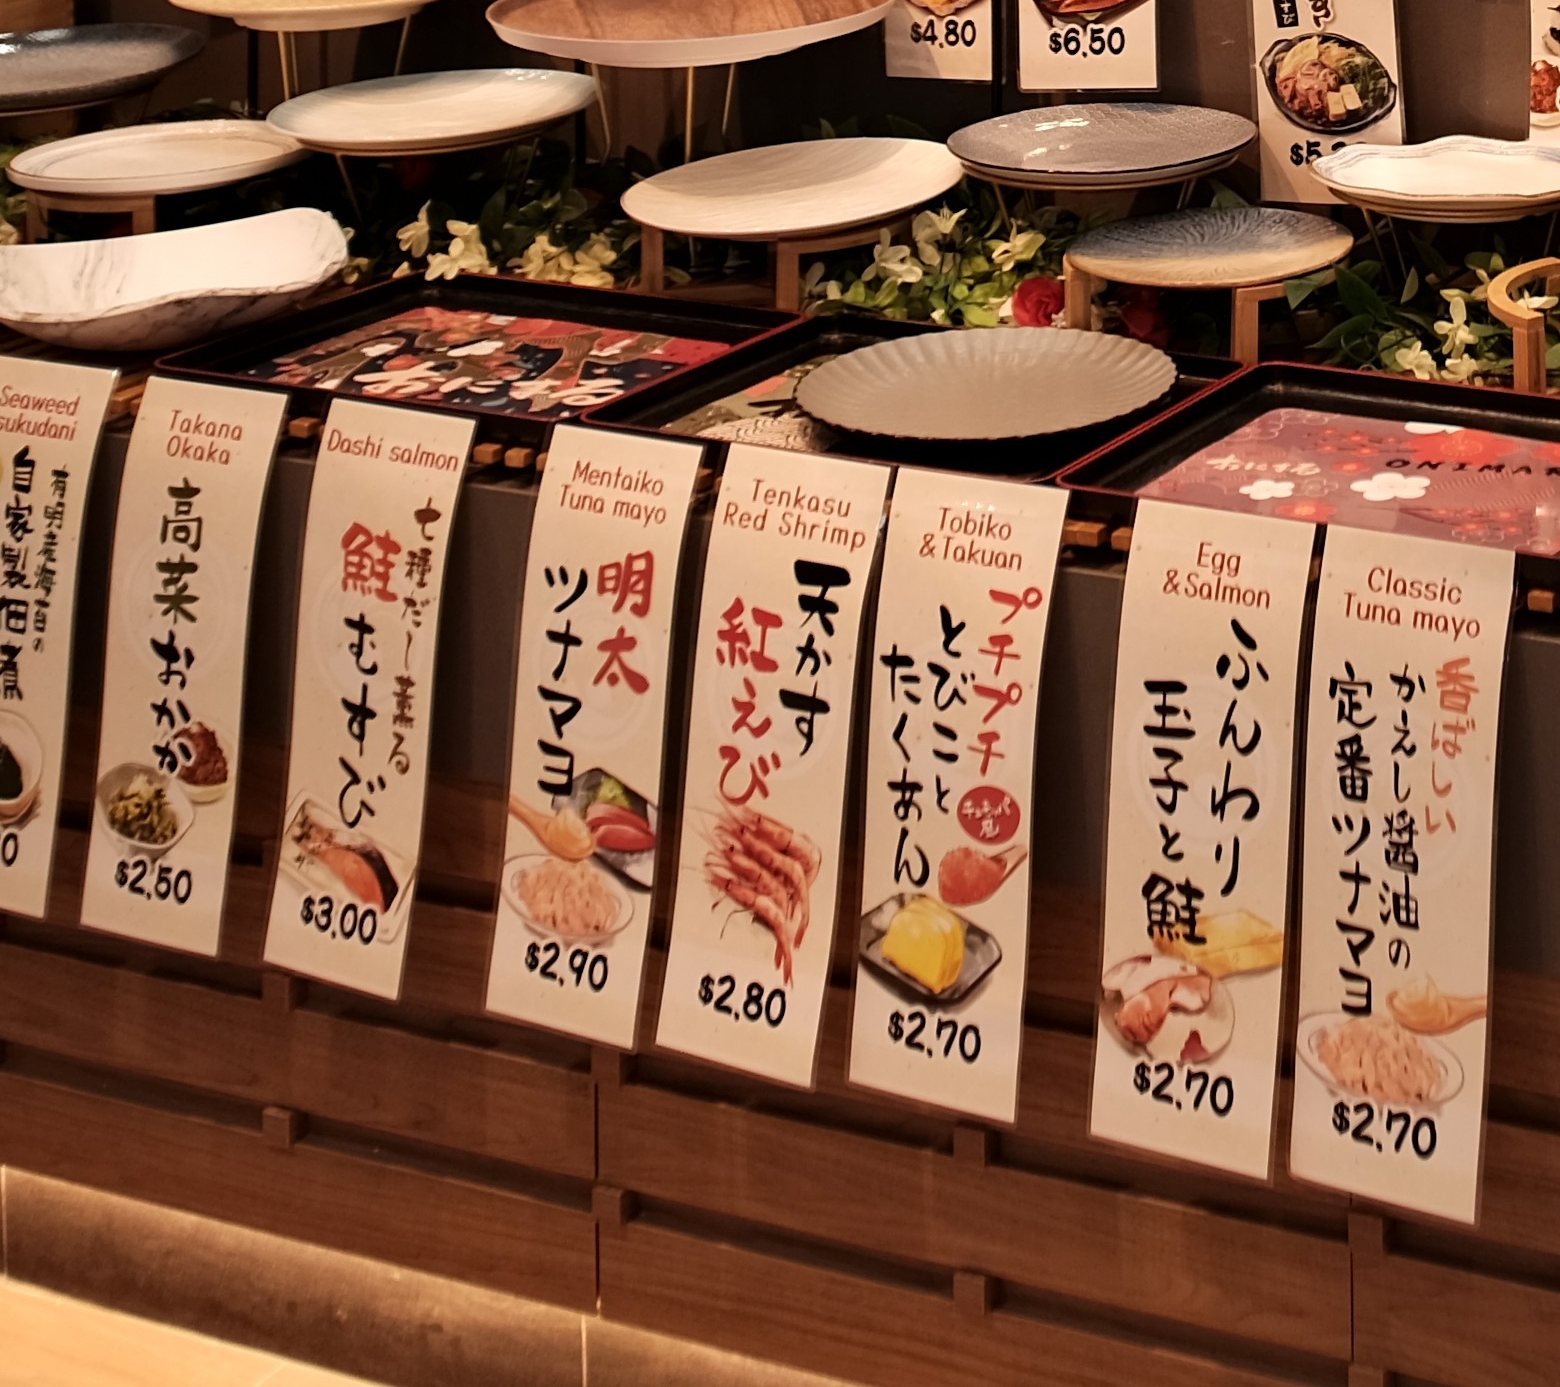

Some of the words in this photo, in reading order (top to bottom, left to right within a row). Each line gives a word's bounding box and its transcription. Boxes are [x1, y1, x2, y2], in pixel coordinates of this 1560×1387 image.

[911, 19, 976, 47] $4.80
[1049, 27, 1125, 57] $6.50
[166, 435, 231, 465] Okaka
[169, 410, 243, 442] Takana
[327, 429, 383, 460] Dashi
[388, 442, 459, 473] salmon
[558, 484, 606, 515] Tuna
[612, 500, 667, 526] mayo
[572, 461, 664, 496] Mentaiko
[751, 478, 851, 519] Tenkasu
[724, 502, 769, 530] Red
[777, 509, 866, 552] Shrimp
[938, 507, 1012, 541] Tobiko
[1197, 541, 1242, 577] Egg
[1367, 566, 1463, 606] Classic
[149, 477, 203, 774] 高菜おかか
[592, 550, 655, 694] 明太
[1343, 591, 1401, 625] Tuna
[1412, 608, 1482, 640] mayo
[338, 522, 402, 828] 鮭むすび
[537, 566, 588, 796] ツナマヨ
[779, 560, 851, 757] 天かす
[967, 586, 1042, 776] プチプチ
[716, 596, 784, 806] 紅えび
[927, 605, 976, 814] とびこと
[880, 645, 930, 890] たくあん
[1211, 618, 1269, 897] ふんわり
[1424, 658, 1480, 836] 香ばしい
[1142, 679, 1207, 945] 玉子と鮭
[1328, 661, 1377, 1017] 定番ツナマヨ
[1379, 663, 1426, 972] かえし醤油の
[115, 858, 192, 905] $2.50
[300, 897, 378, 945] $3.00
[525, 942, 609, 992] $2.90
[699, 974, 787, 1028] $2.80
[889, 1009, 981, 1063] $2.70
[1133, 1061, 1235, 1116] $2.70
[1332, 1103, 1438, 1160] $2.70
